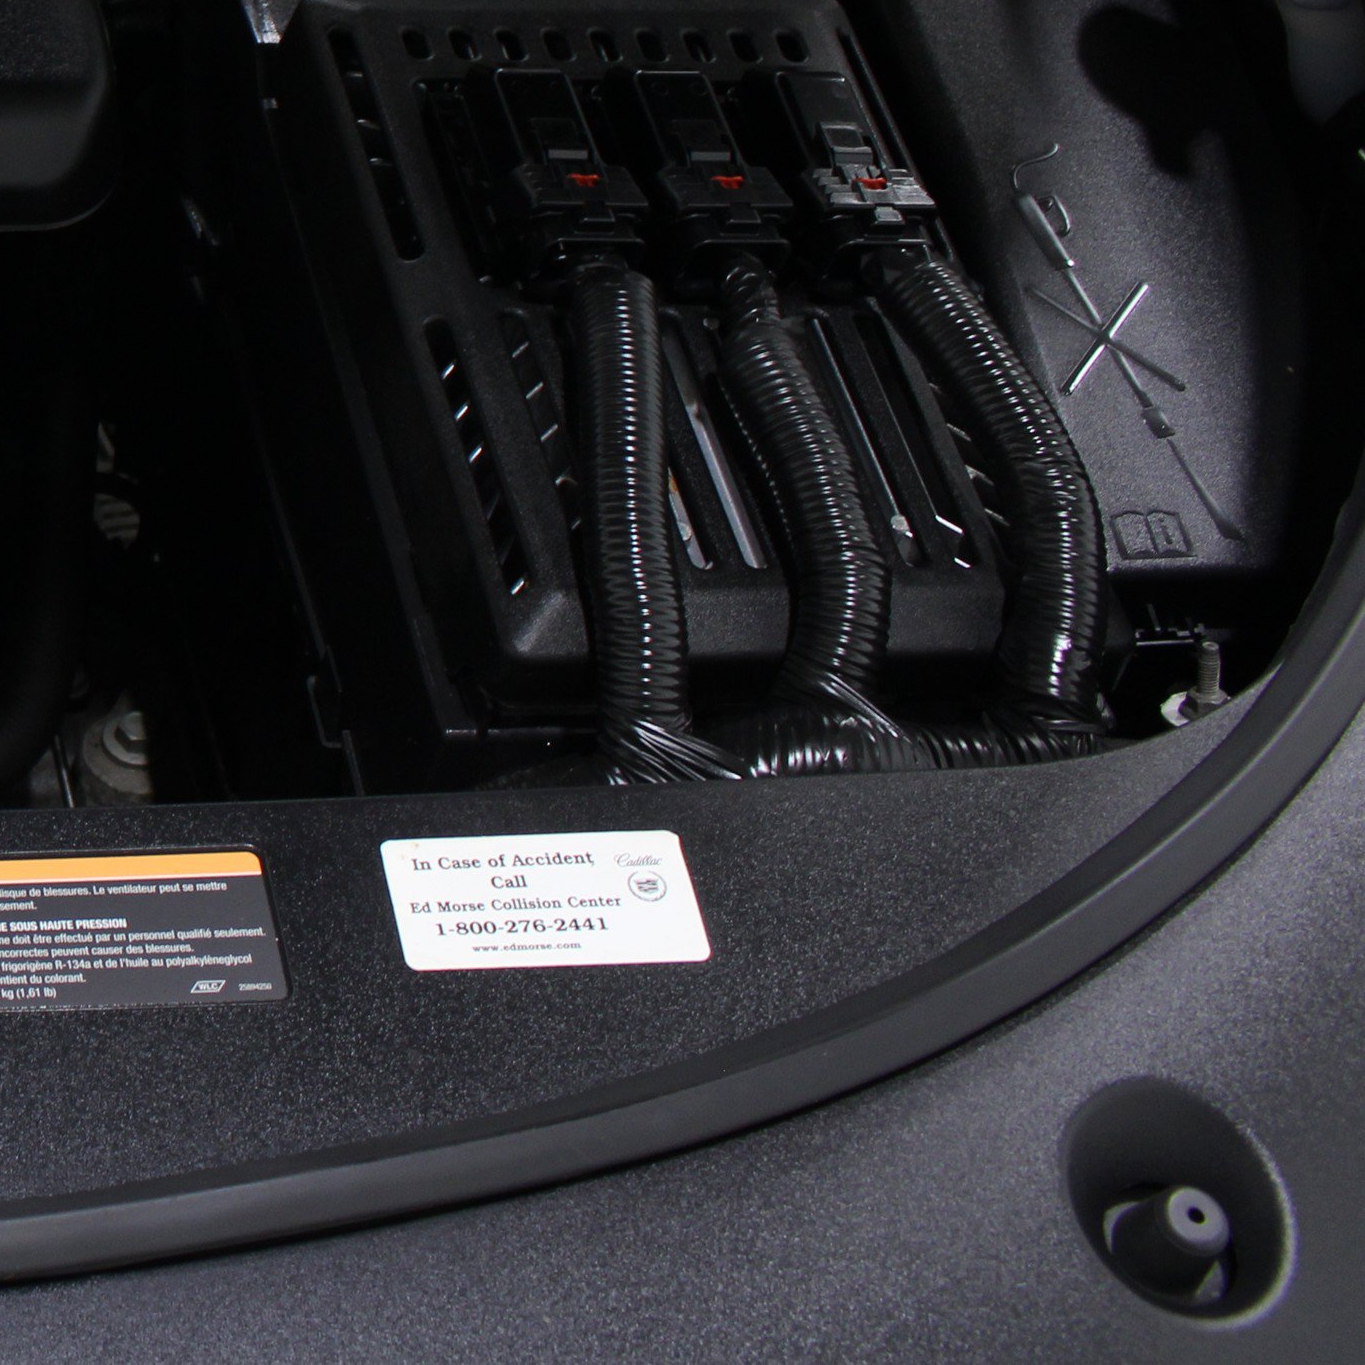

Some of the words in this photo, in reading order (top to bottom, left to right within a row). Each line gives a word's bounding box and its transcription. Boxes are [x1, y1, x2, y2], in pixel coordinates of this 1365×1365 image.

[412, 859, 432, 870] In
[438, 857, 481, 869] Case
[488, 854, 506, 867] of
[614, 853, 662, 867] Cadillac
[491, 875, 527, 888] Call
[29, 888, 41, 897] de
[44, 887, 91, 896] blessures.
[93, 886, 105, 895] Le
[107, 884, 156, 894] ventilateur
[159, 883, 180, 894] peut
[182, 884, 194, 892] se
[196, 882, 227, 891] mettre
[410, 902, 431, 913] Ed
[437, 901, 485, 912] Morse
[491, 897, 562, 910] Collision
[567, 896, 621, 908] Center
[10, 922, 37, 931] SOUS
[40, 920, 73, 930] HAUTE
[76, 918, 127, 929] PRESSION
[436, 917, 608, 935] 1-800-276-2441
[472, 942, 581, 952] www.edmorse.com
[1, 988, 14, 1000] kg
[17, 988, 40, 999] (1,61
[44, 988, 56, 998] lb)
